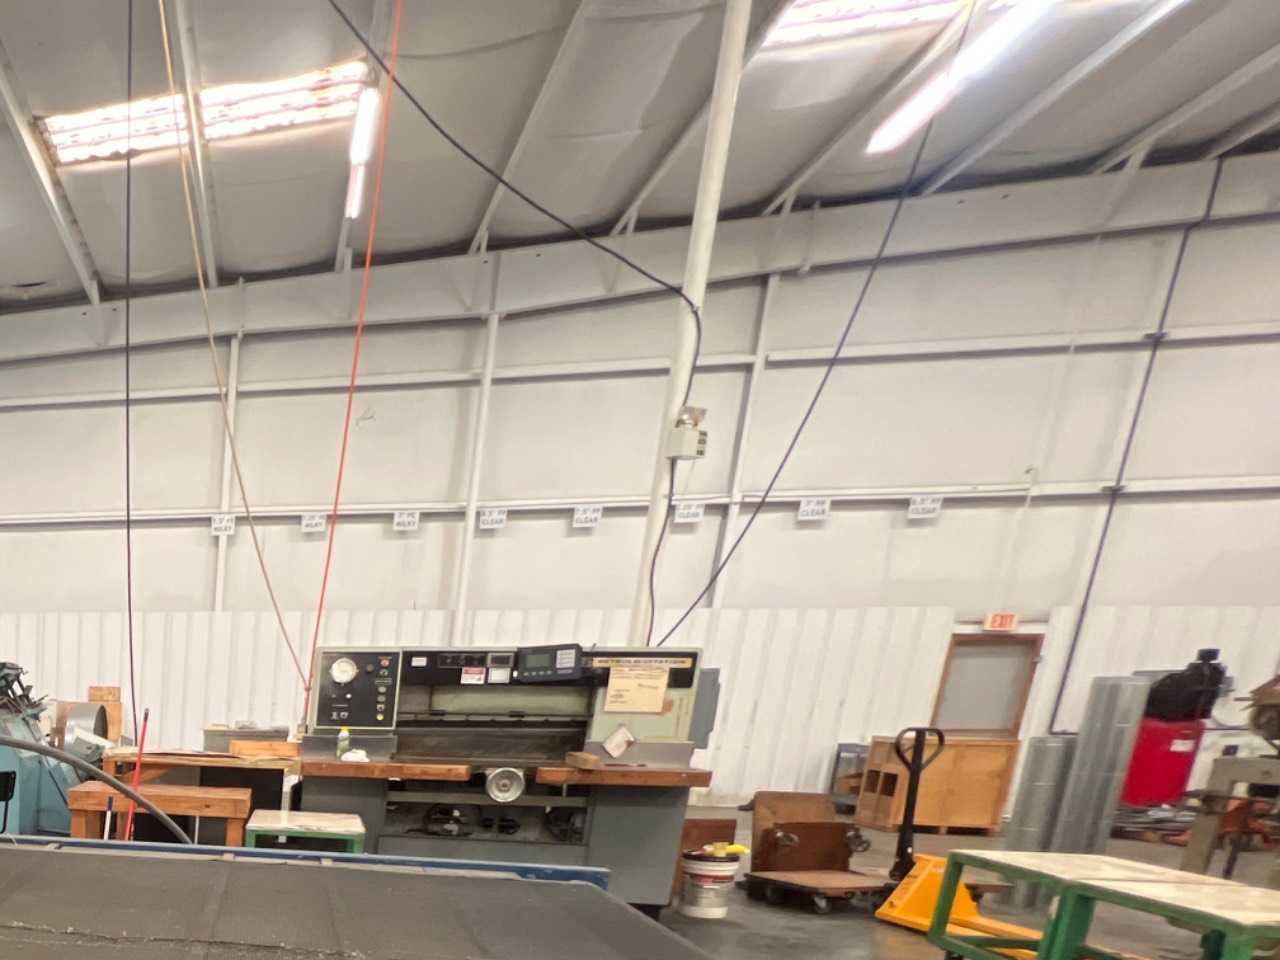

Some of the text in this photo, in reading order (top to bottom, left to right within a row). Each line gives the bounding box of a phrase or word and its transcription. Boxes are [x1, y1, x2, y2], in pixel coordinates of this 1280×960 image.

[677, 511, 701, 519] CLEAR
[800, 508, 826, 517] CLEAR
[481, 518, 504, 526] CLEAR
[575, 515, 599, 524] CLEAR
[396, 520, 417, 528] MILKY
[214, 525, 233, 533] MILKY
[992, 614, 1017, 628] EXIT
